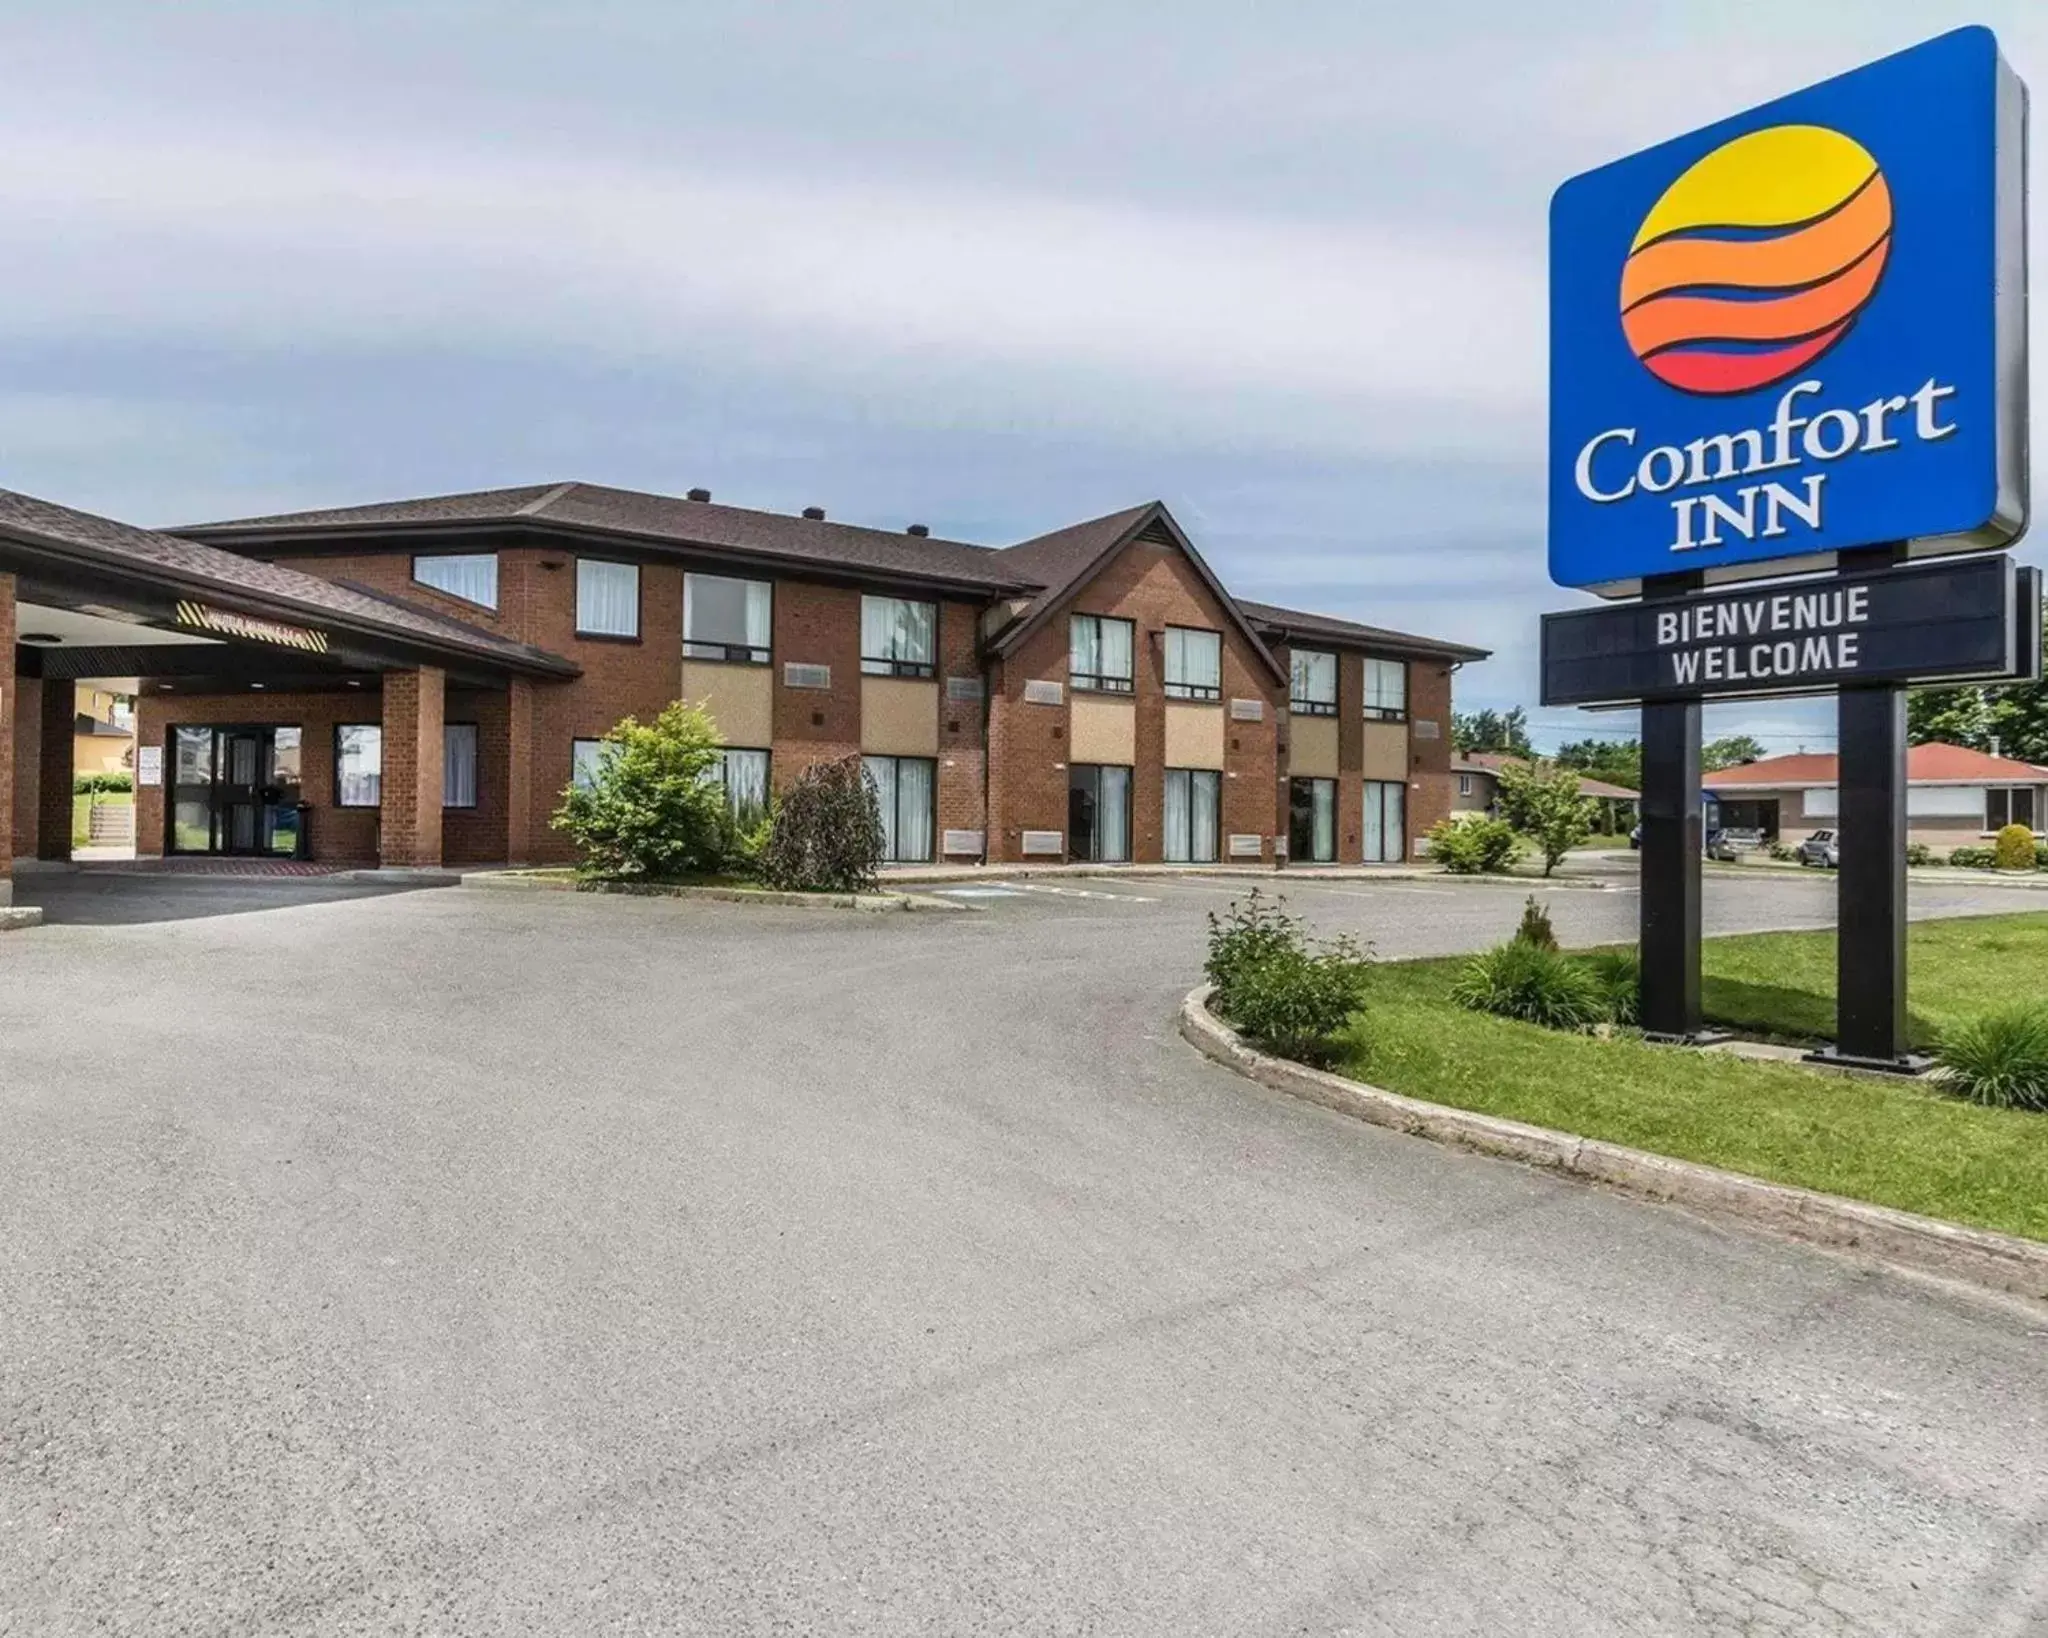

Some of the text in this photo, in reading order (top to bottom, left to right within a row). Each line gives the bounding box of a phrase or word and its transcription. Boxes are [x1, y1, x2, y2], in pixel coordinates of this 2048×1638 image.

[1575, 378, 1957, 503] Comfort
[1669, 473, 1827, 552] INN
[1657, 586, 1869, 645] BIENVENUE
[1671, 633, 1859, 685] WELCOME
